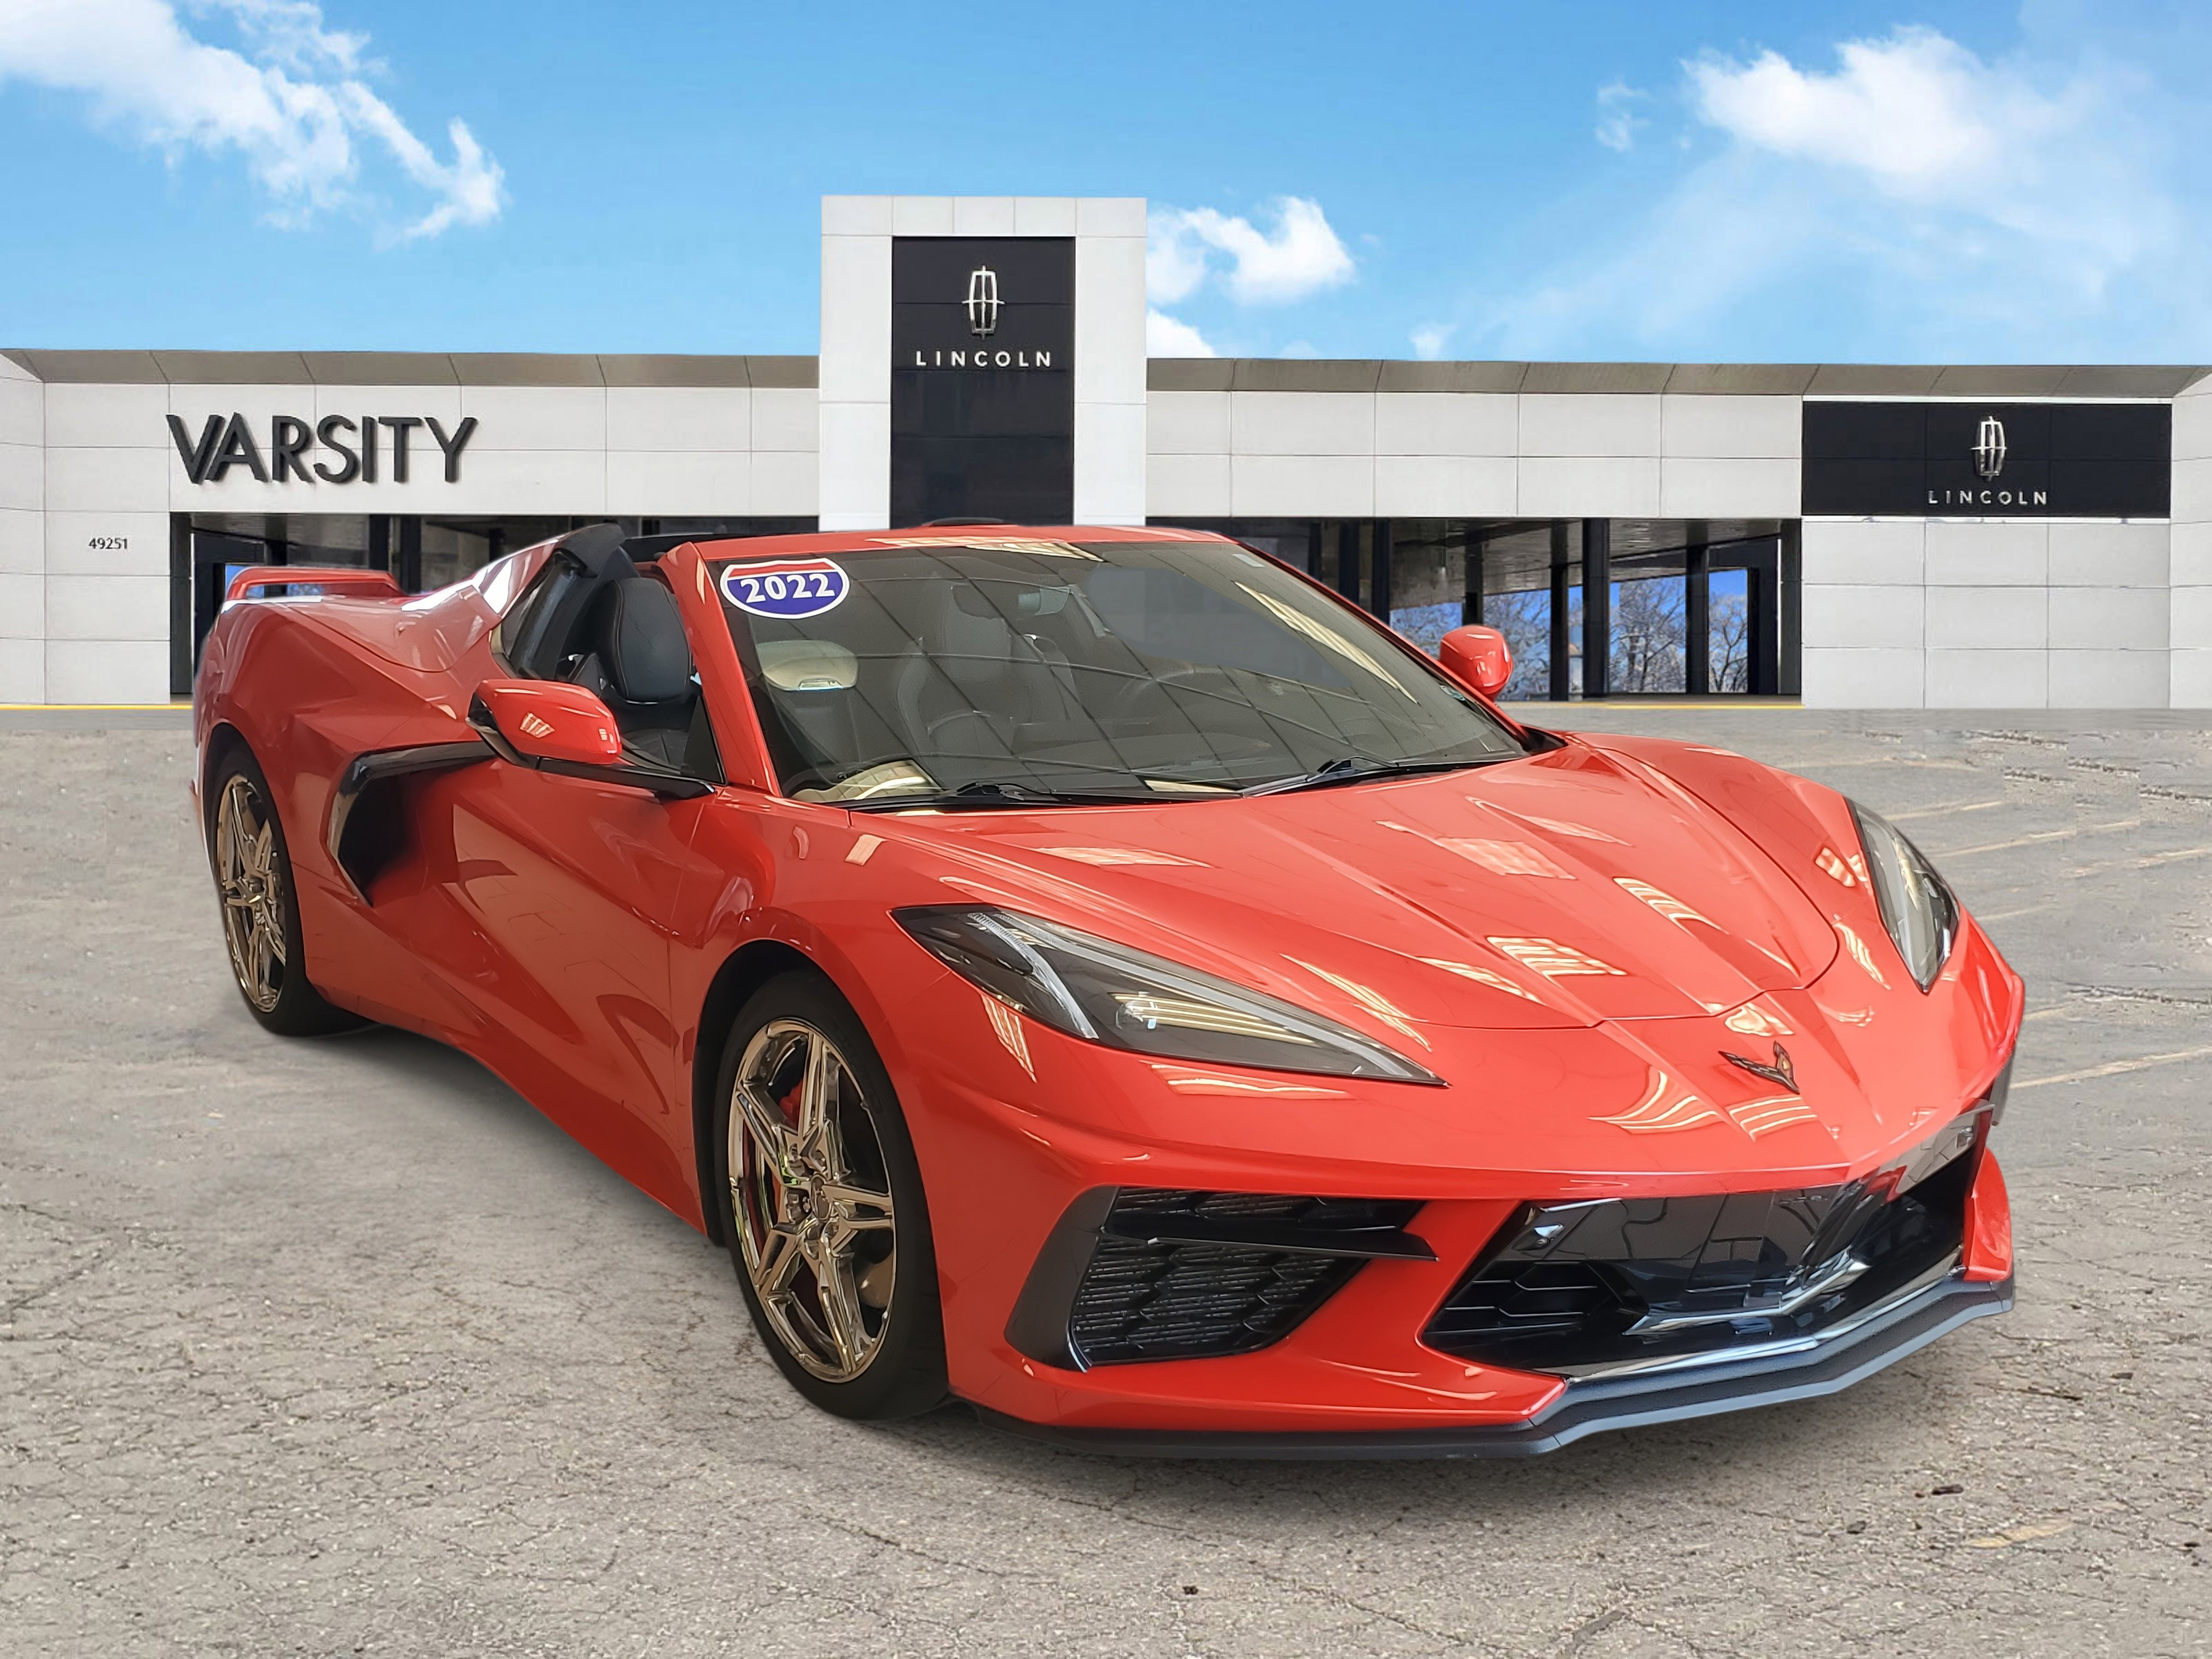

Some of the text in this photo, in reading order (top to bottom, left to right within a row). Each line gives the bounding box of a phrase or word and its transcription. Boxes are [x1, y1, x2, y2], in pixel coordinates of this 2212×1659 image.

[916, 351, 1050, 367] LINCOLN
[166, 412, 479, 485] VARSITY
[1928, 490, 2047, 505] LINCOLN
[89, 537, 128, 549] 49251
[741, 574, 835, 603] 2022
